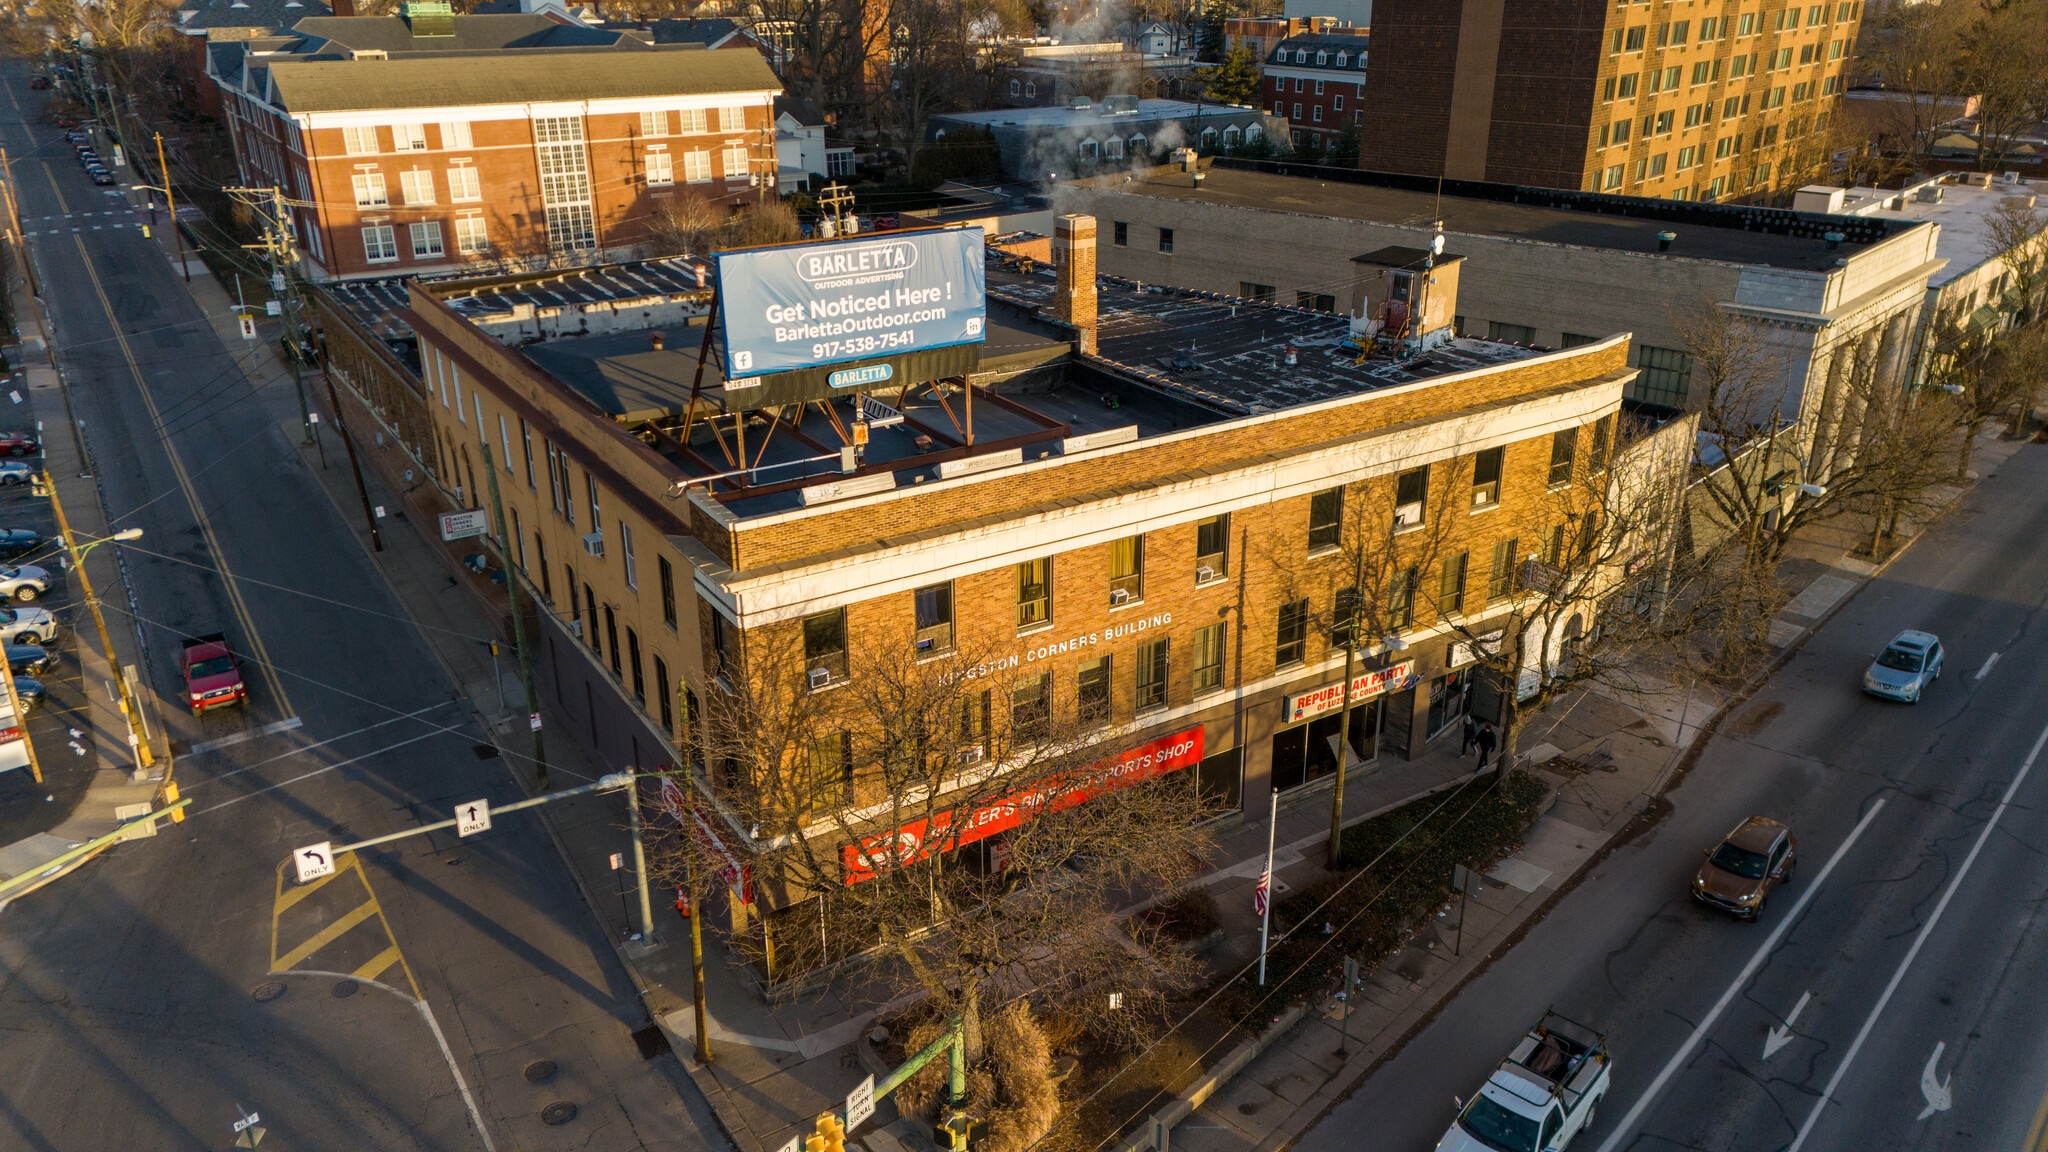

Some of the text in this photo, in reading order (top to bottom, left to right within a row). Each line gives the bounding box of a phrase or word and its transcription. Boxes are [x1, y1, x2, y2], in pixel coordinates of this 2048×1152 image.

[810, 248, 905, 276] BARLETTA
[815, 272, 904, 289] OUTDOOR ADVERTISING
[766, 282, 952, 324] Get Noticed Here !
[775, 305, 946, 343] BarlettaOutdoor.com
[813, 329, 914, 359] 917-538-7541
[834, 366, 887, 385] BARLETTA
[1027, 633, 1097, 662] CORNERS
[1105, 613, 1172, 641] BUILDING
[1297, 664, 1406, 709] REPUBLIAN PARTY
[1317, 702, 1327, 711] OF
[1359, 683, 1386, 697] COUNTY
[1155, 740, 1194, 763] SHOP
[463, 821, 486, 833] ONLY
[304, 865, 329, 877] ONLY
[851, 1083, 869, 1103] RIGHT
[852, 1094, 869, 1112] TURN
[850, 1104, 871, 1126] SIGNAL
